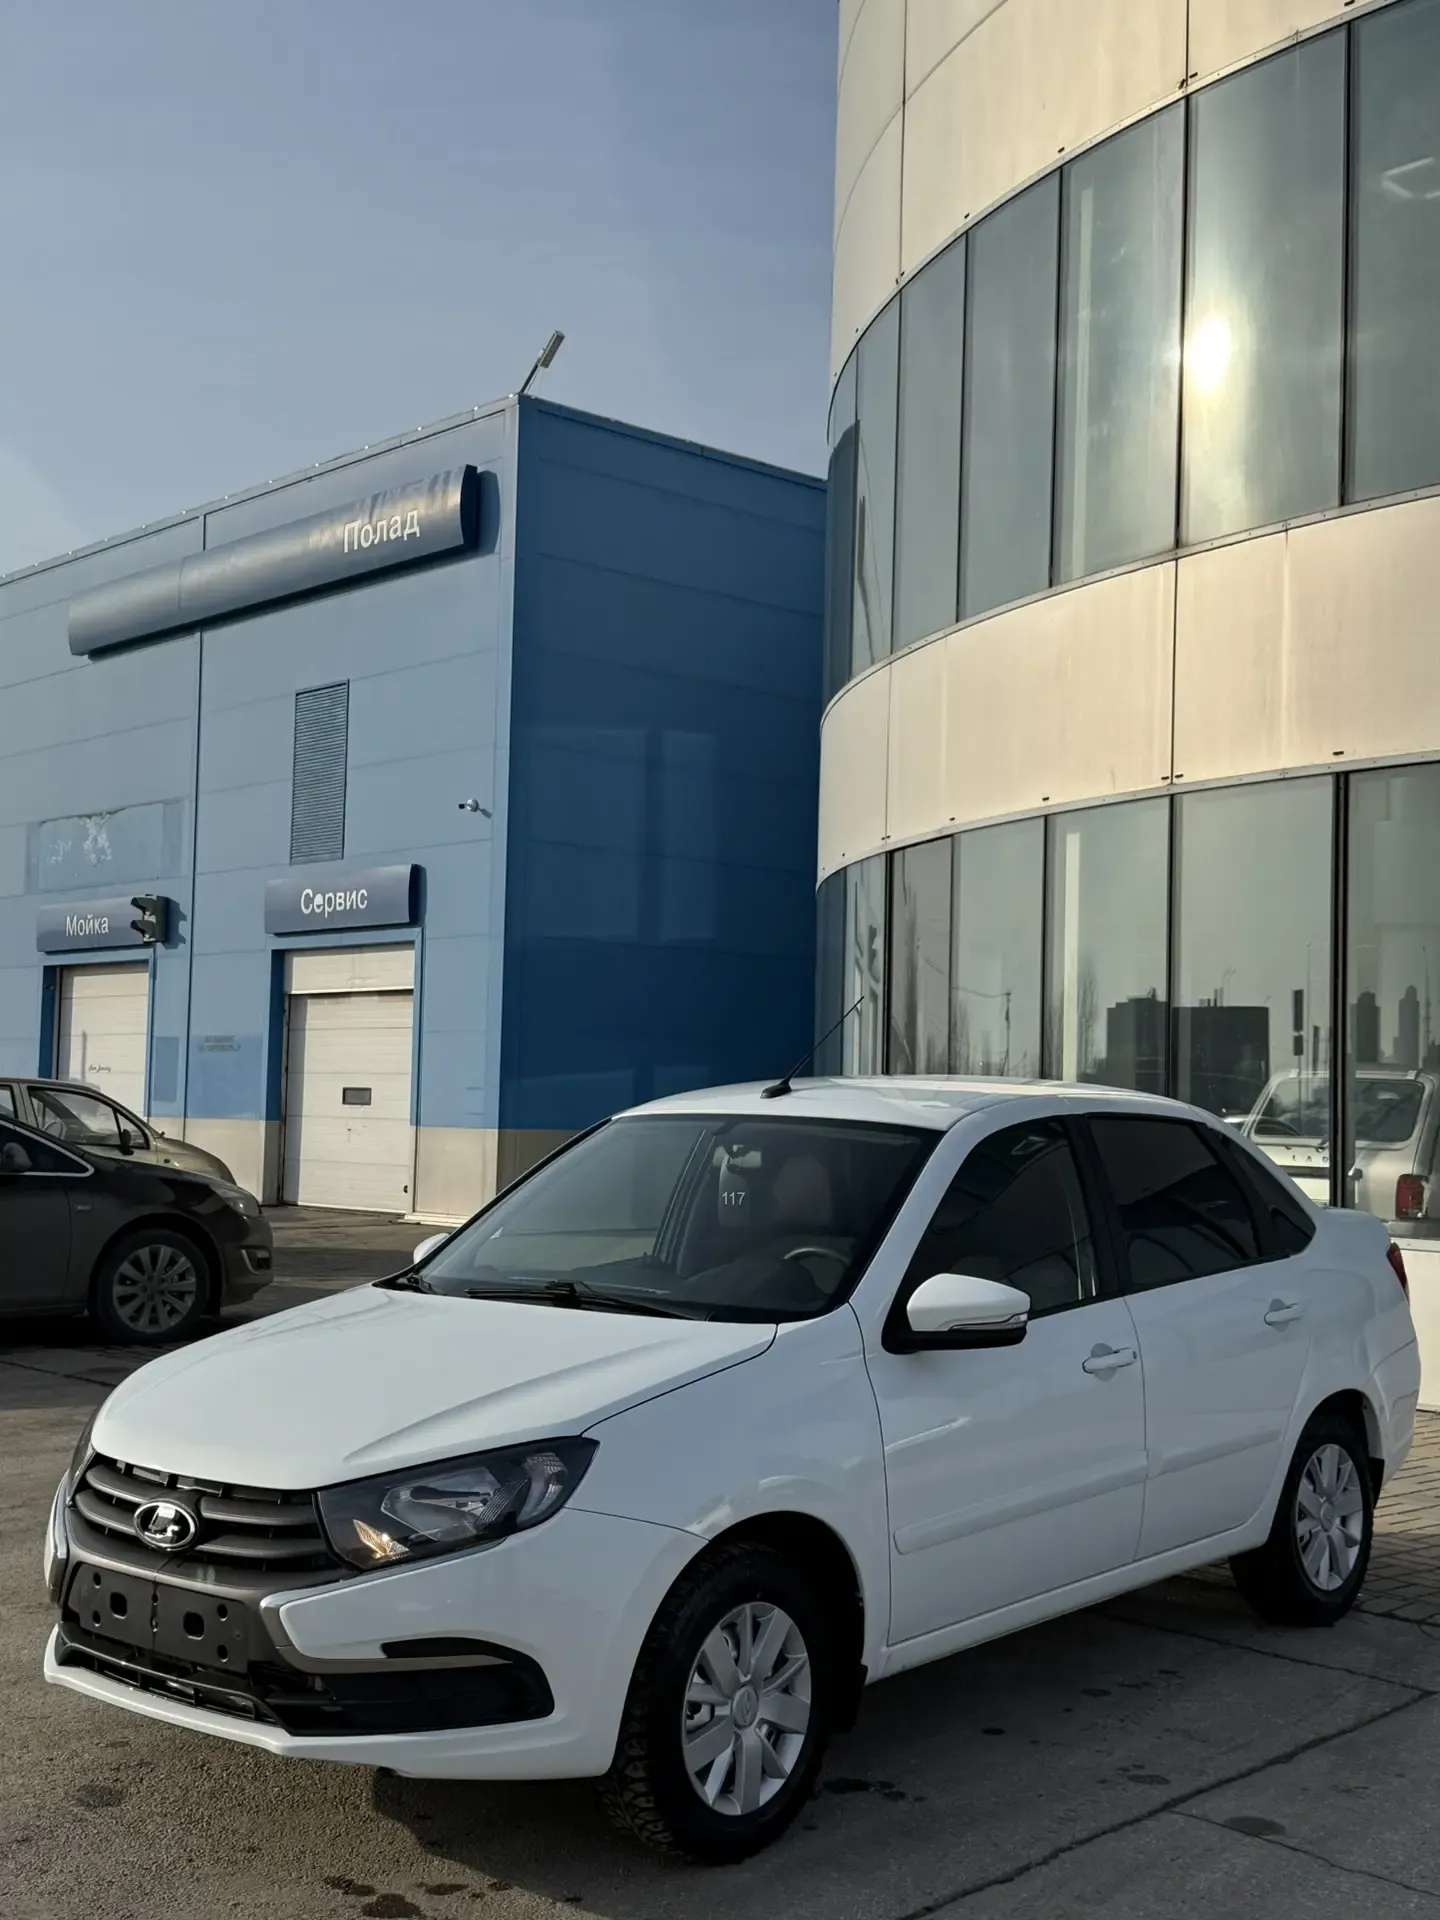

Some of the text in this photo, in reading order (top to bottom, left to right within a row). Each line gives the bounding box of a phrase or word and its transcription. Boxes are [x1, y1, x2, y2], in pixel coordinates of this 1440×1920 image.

[344, 510, 420, 553] Полад
[300, 888, 368, 918] Сервис
[65, 914, 109, 937] Мойка
[722, 1191, 746, 1206] 117
